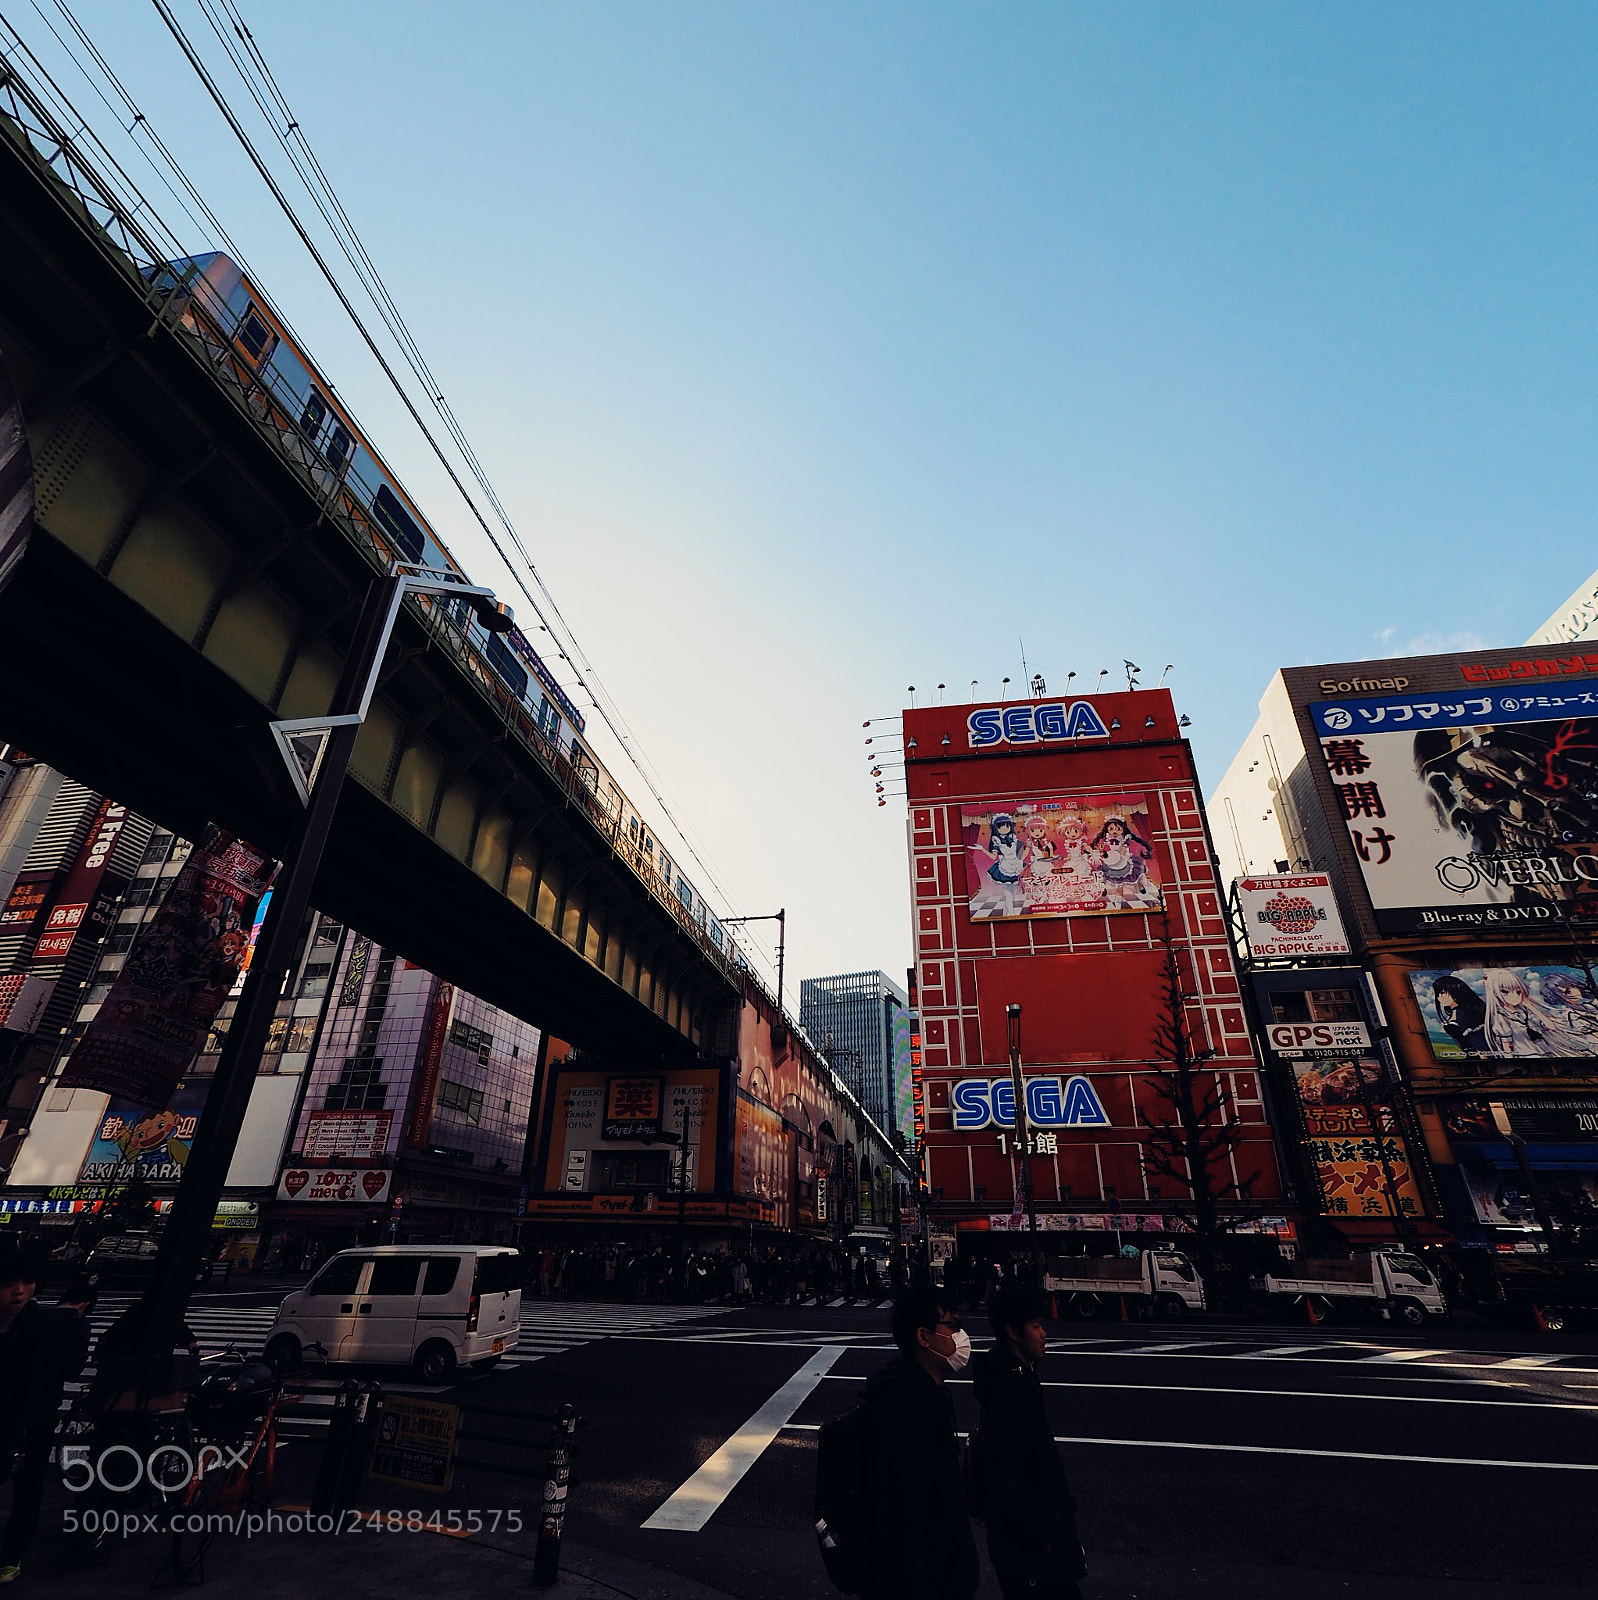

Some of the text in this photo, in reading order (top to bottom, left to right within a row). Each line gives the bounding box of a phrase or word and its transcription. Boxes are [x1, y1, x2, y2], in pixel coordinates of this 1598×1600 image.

[1319, 676, 1409, 695] Sofmap
[1358, 697, 1493, 724] ソフマップ
[967, 702, 1109, 747] SEGA
[1321, 739, 1396, 865] 幕開け
[85, 821, 124, 869] Free
[50, 907, 82, 925] 免税
[1257, 908, 1327, 923] BIG APPLE
[1421, 910, 1484, 925] Blu-ray
[1485, 909, 1500, 922] &
[1503, 906, 1550, 921] DVD
[38, 937, 71, 952] 면세점
[1253, 944, 1276, 955] BIG
[1272, 1025, 1334, 1048] GPS
[1335, 1036, 1364, 1046] next
[562, 1088, 603, 1097] SHISEIDO
[669, 1086, 714, 1096] SHISEIDO
[576, 1099, 598, 1107] KOSÉ
[615, 1080, 654, 1118] 薬
[951, 1075, 1113, 1130] SEGA
[563, 1110, 596, 1119] Kanebo
[1304, 1107, 1364, 1120] ステーキ&
[173, 1115, 198, 1139] 迎
[564, 1121, 593, 1129] SOFINA
[605, 1125, 657, 1138] マツモトキヨシ
[1316, 1119, 1373, 1132] ハンバー
[315, 1171, 357, 1187] LOVE
[1318, 1163, 1411, 1196] ラーメン
[226, 1216, 256, 1226] ONODEN
